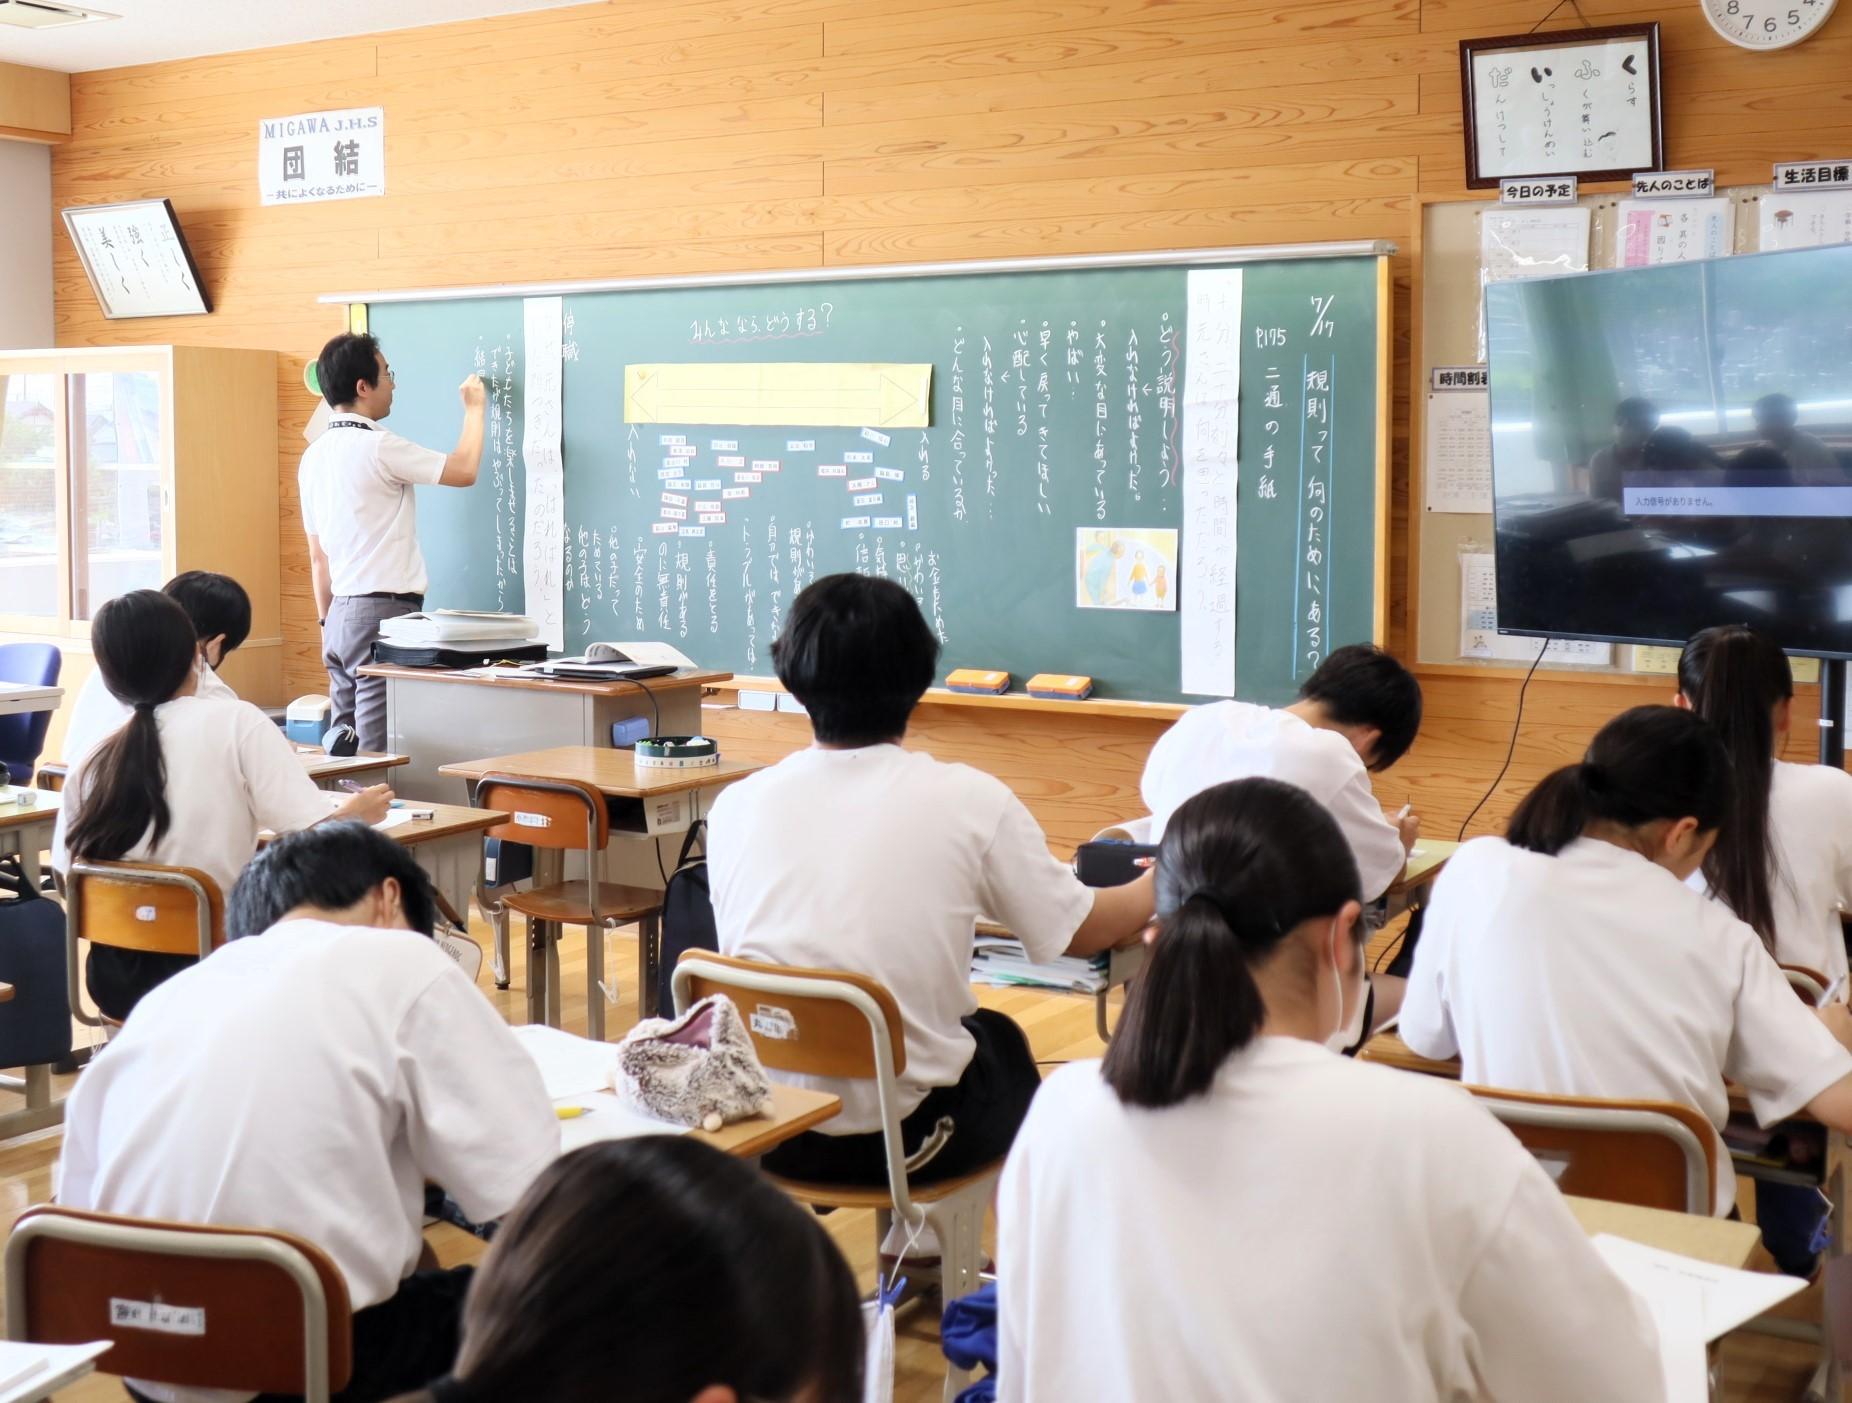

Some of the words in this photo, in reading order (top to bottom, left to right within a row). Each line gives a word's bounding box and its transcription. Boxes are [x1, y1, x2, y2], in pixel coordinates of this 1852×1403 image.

[1727, 0, 1740, 15] 8
[1742, 14, 1755, 30] 7
[1763, 17, 1777, 33] 6
[1787, 9, 1800, 25] 5
[1621, 54, 1638, 107] くらす
[264, 117, 331, 139] MIGAWA
[334, 116, 378, 132] J.H.S
[1784, 167, 1850, 185] 生活目標
[1506, 183, 1571, 199] 今日の予定
[1636, 177, 1709, 193] 先人のことば
[1012, 330, 1030, 436] 心配している
[1257, 366, 1282, 500] 二通の手紙
[917, 431, 930, 480] 入れる
